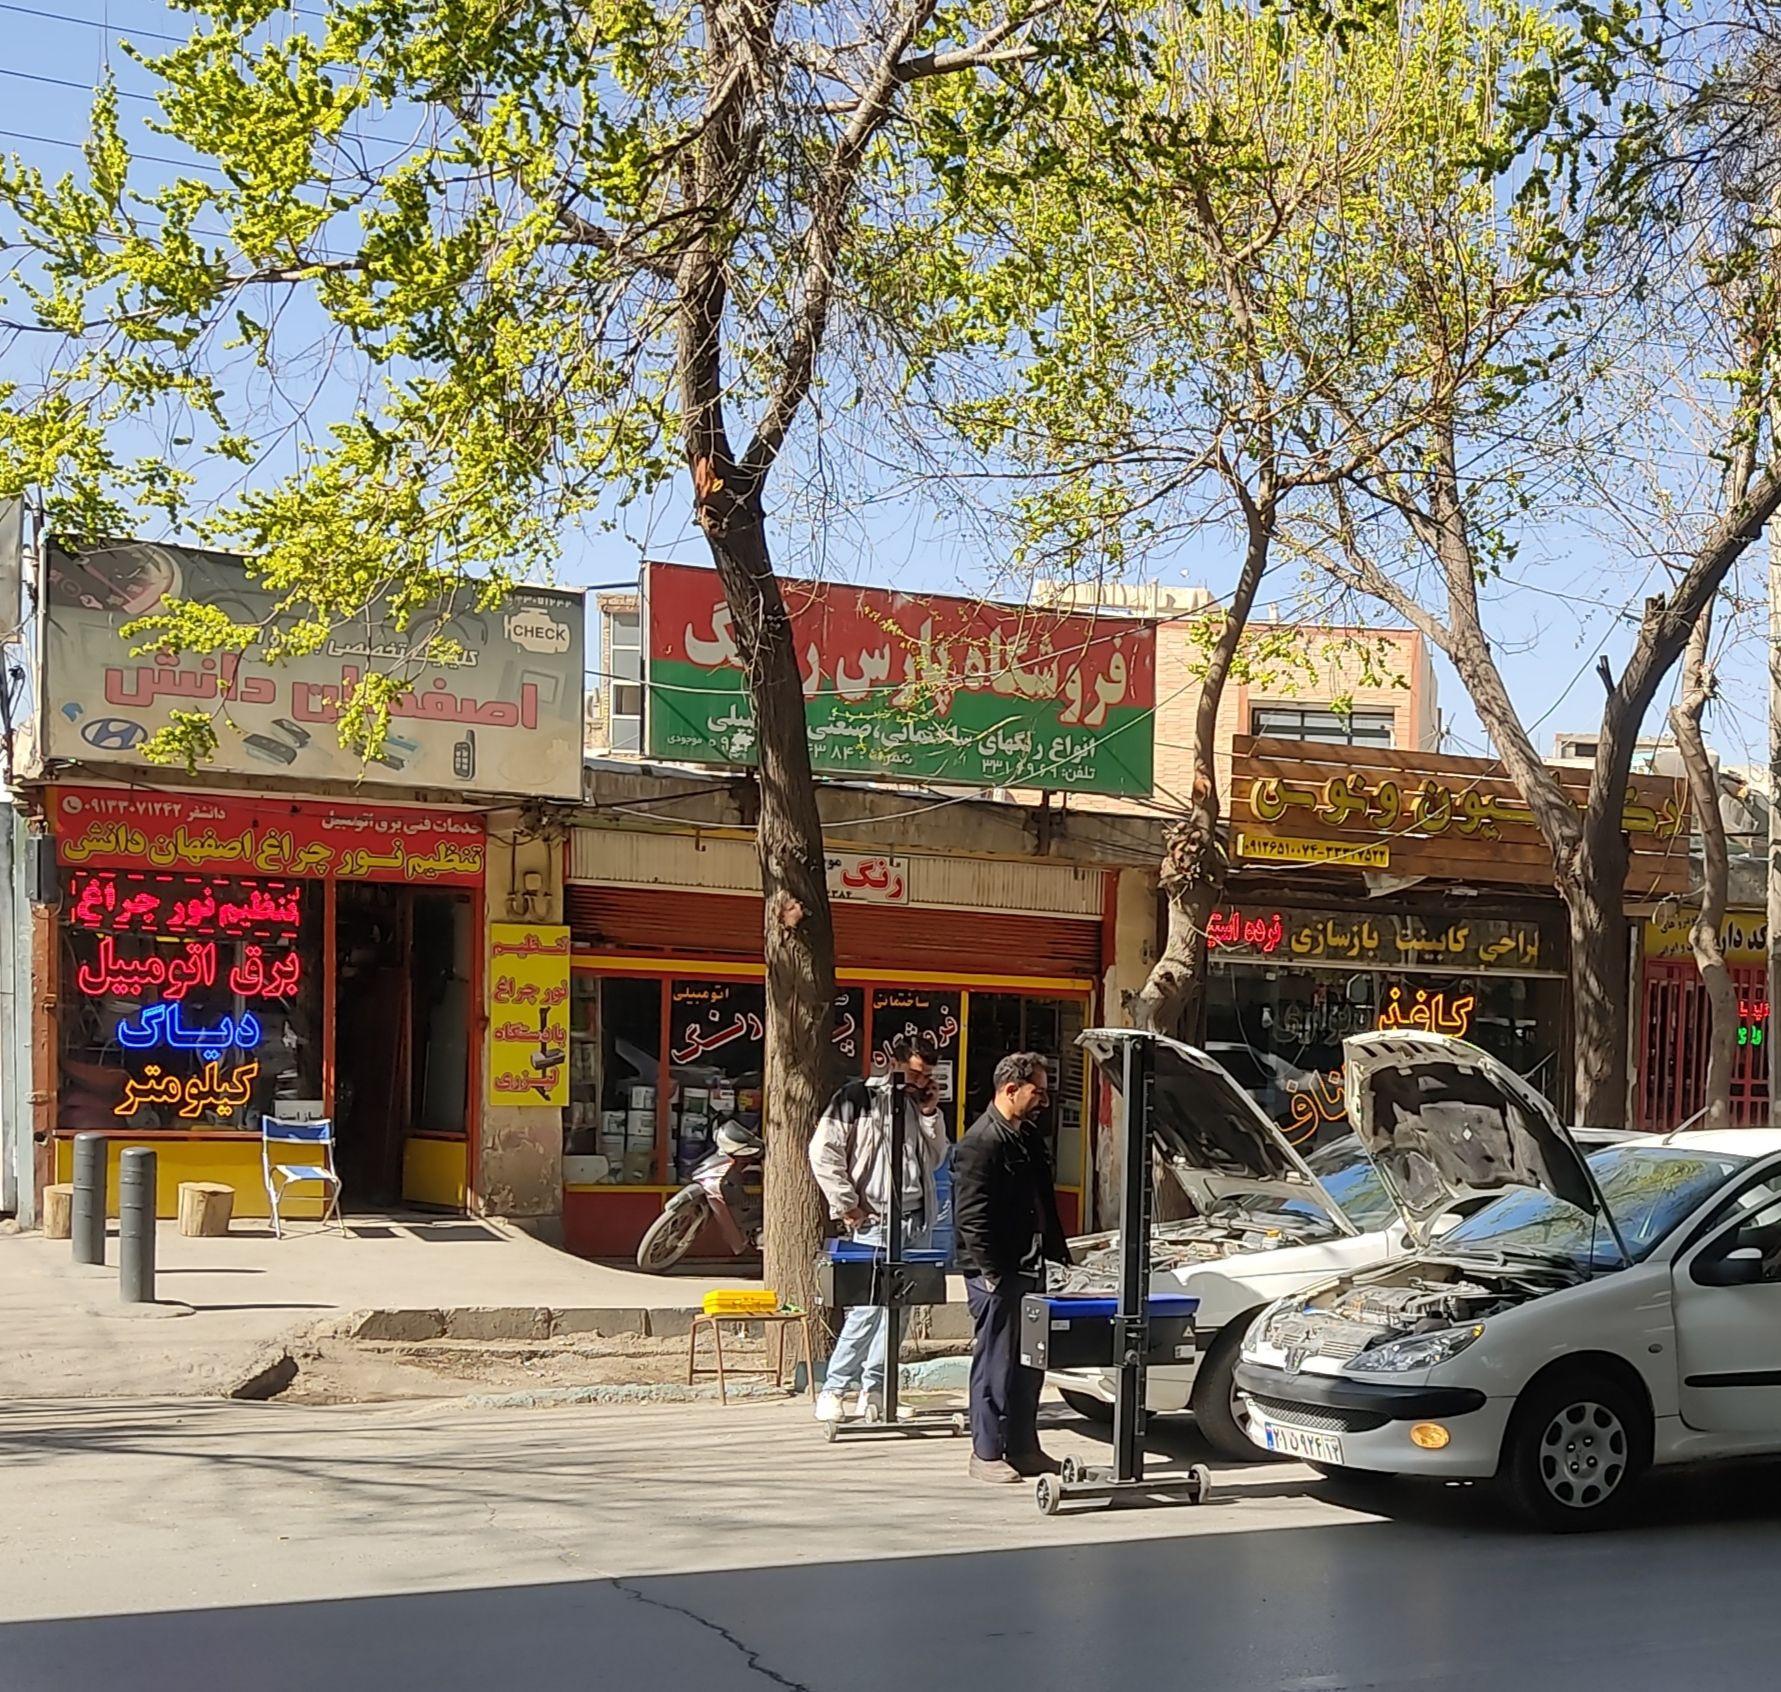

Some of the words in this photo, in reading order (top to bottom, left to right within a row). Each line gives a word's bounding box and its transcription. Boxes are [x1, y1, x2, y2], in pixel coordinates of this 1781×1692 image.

[513, 624, 566, 641] CHECK
[684, 601, 820, 698] رگ
[105, 644, 277, 708] دانش
[836, 616, 953, 716] پارس
[964, 624, 1128, 728] فروشگاه
[807, 715, 873, 741] صنعتی
[1050, 735, 1097, 764] انواع
[1061, 765, 1097, 783] تلفن:
[186, 805, 226, 822] دانشفر
[1249, 773, 1400, 831] ونوس
[62, 820, 148, 862] دانش
[374, 815, 402, 833] برق
[403, 815, 432, 835] فنی
[433, 817, 483, 835] خدمات
[149, 824, 255, 867] اصفهان
[255, 828, 336, 877] چراغ
[333, 838, 406, 877] نور
[405, 839, 485, 880] تنظیم
[841, 857, 906, 900] رنگ
[166, 886, 217, 927] نور
[219, 886, 301, 928] تنظیم
[493, 932, 570, 960] تنظیم
[1290, 918, 1380, 958] بازسازی
[1395, 925, 1470, 961] کابینت
[78, 935, 218, 999] اتومبیل
[230, 945, 300, 998] برق
[541, 978, 570, 1006] نور
[671, 983, 730, 1006] اتومبیلی
[872, 993, 931, 1009] ساختمانی
[1378, 987, 1475, 1038] کاغذ
[117, 1001, 261, 1061] دیاگ
[670, 1008, 764, 1065] رنگ
[113, 1058, 260, 1118] کیلومتر
[493, 1066, 561, 1093] لیزری
